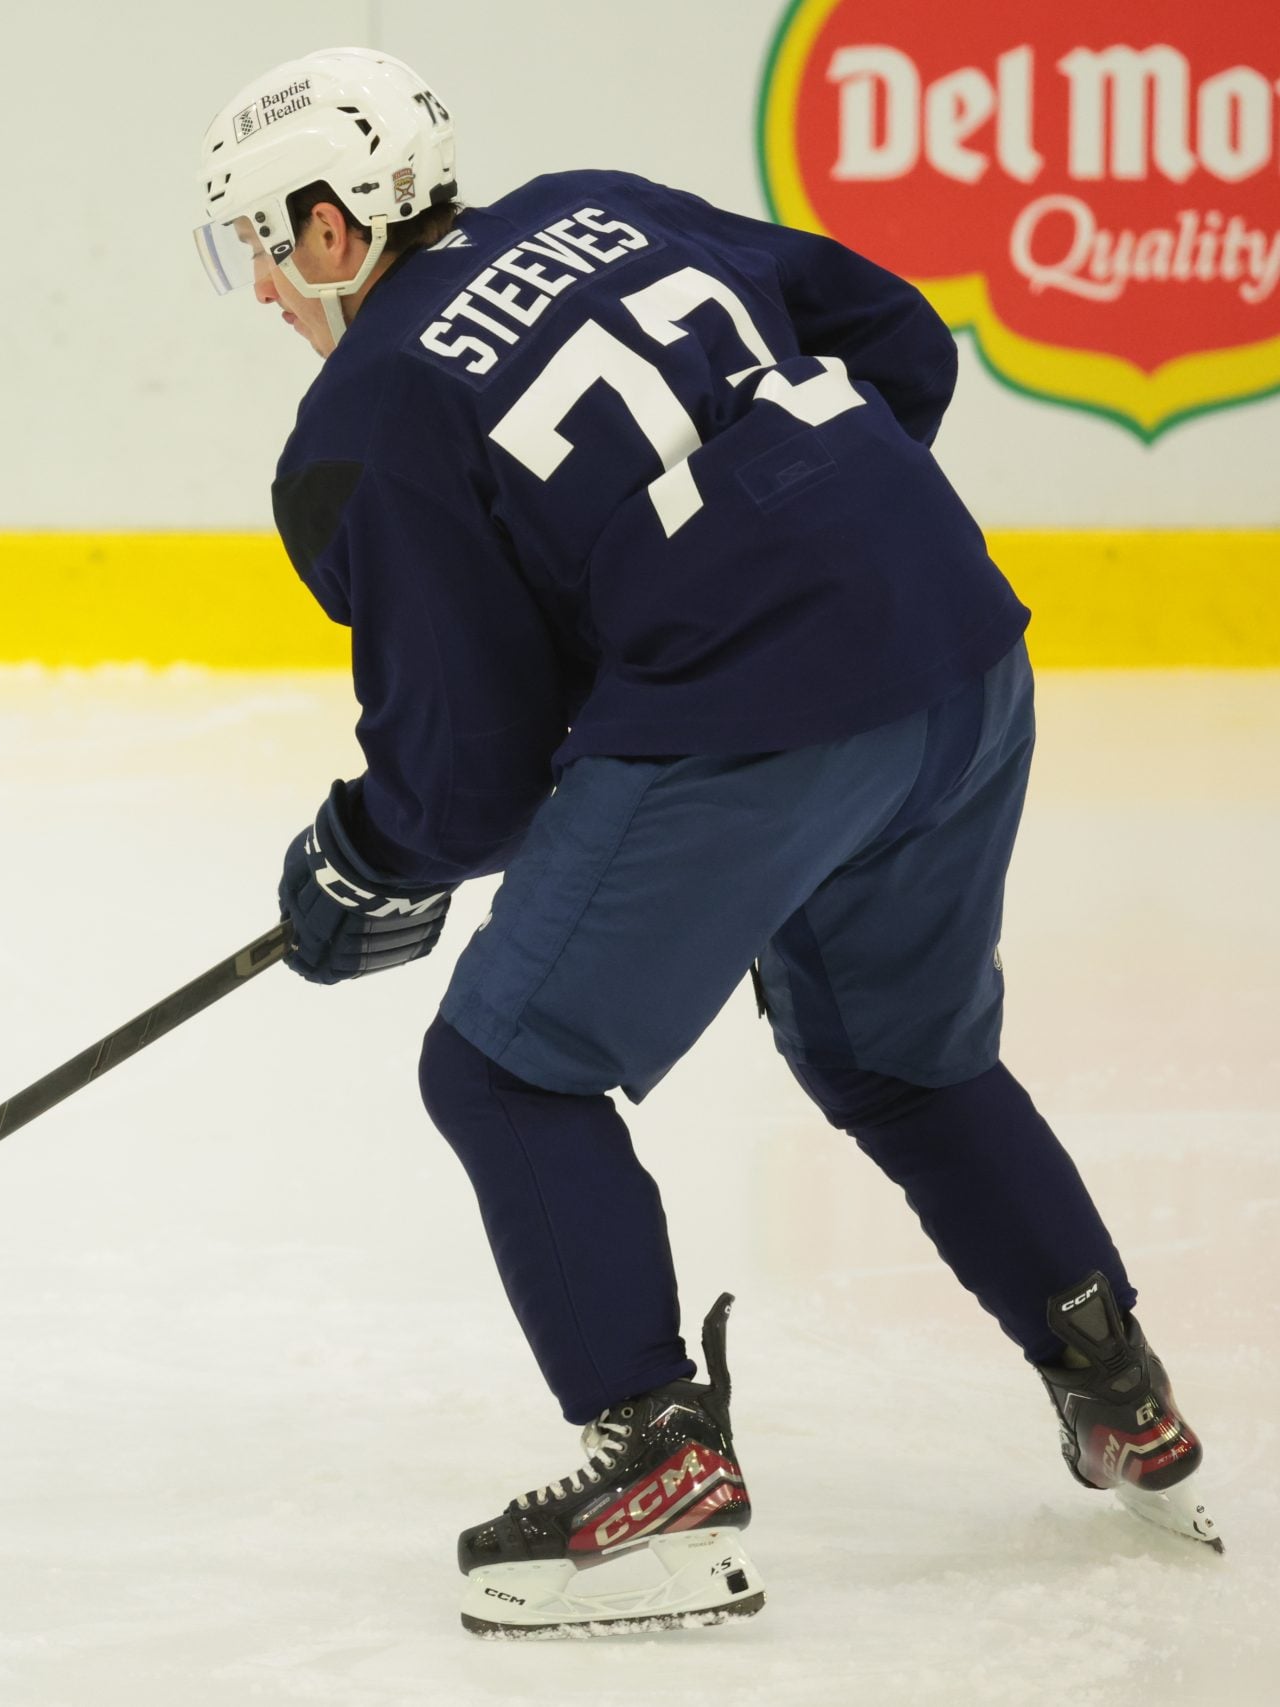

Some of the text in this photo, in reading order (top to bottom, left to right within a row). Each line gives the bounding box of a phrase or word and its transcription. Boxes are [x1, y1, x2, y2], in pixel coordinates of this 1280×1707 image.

[260, 78, 311, 110] Baptist
[263, 94, 312, 126] Health
[826, 43, 1280, 185] Del Mo
[1009, 193, 1280, 303] Quality
[419, 207, 649, 375] STEEVES
[1061, 1283, 1099, 1312] CCM
[594, 1450, 705, 1547] CCM
[484, 1587, 526, 1606] CCM
